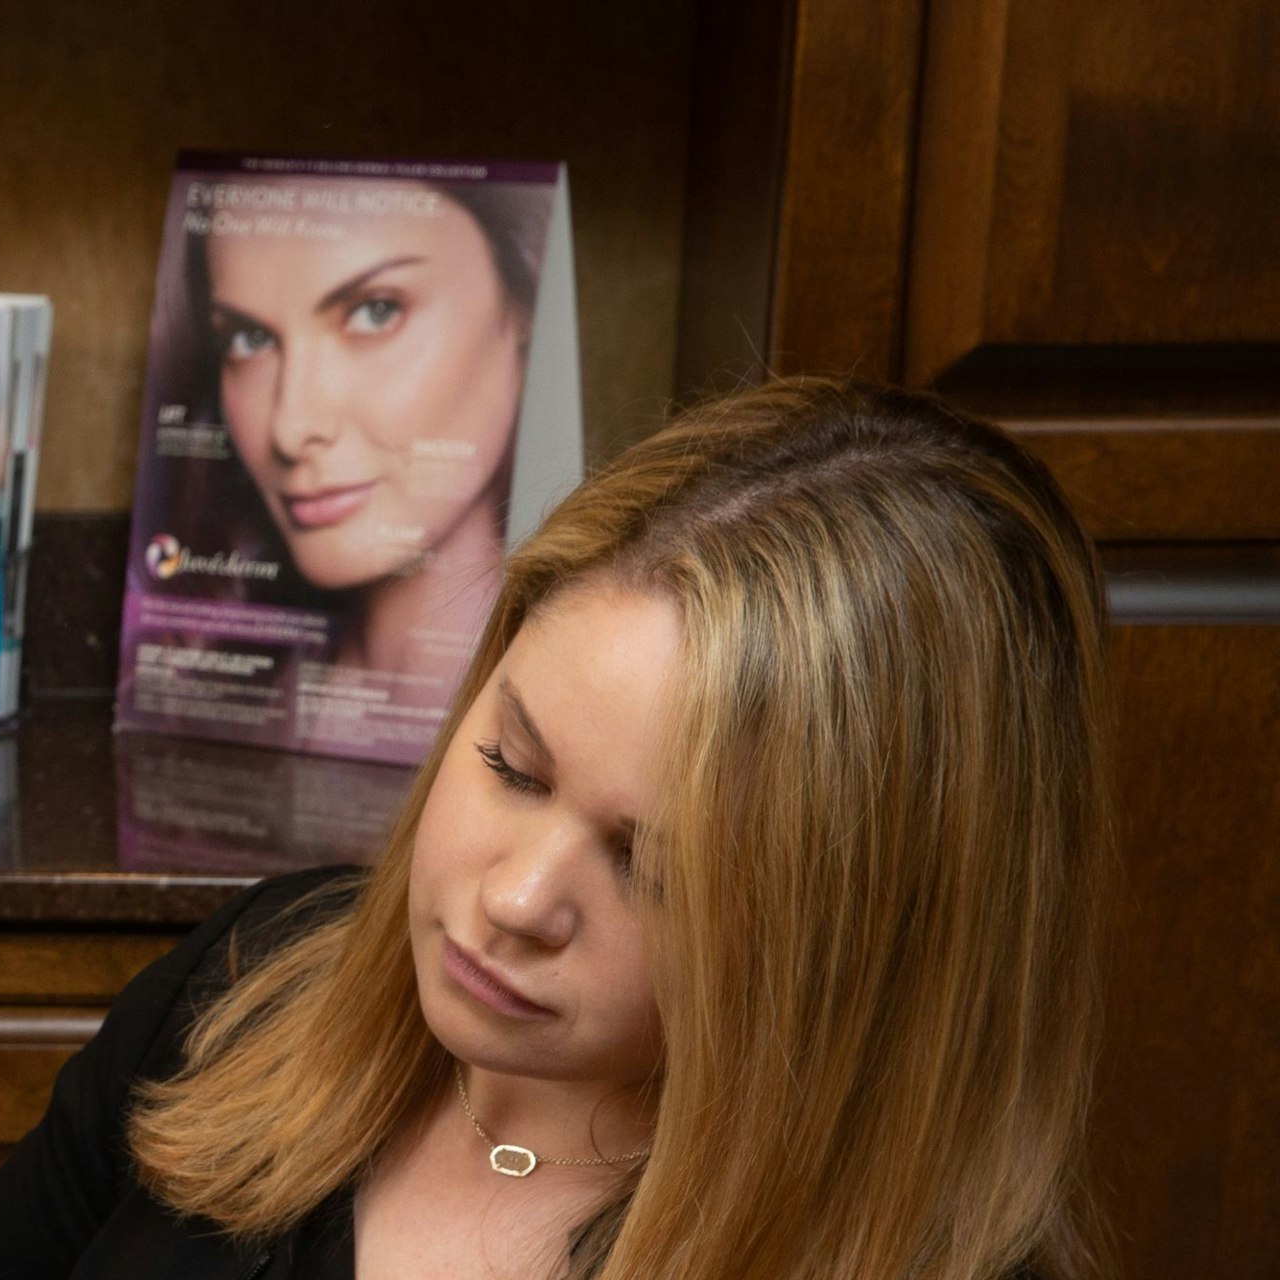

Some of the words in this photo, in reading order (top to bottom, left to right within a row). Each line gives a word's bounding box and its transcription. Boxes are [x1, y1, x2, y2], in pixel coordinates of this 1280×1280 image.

[188, 182, 298, 211] EVERYONE
[303, 189, 352, 214] WILL
[184, 210, 210, 235] No
[212, 211, 250, 237] One
[253, 214, 290, 237] Will
